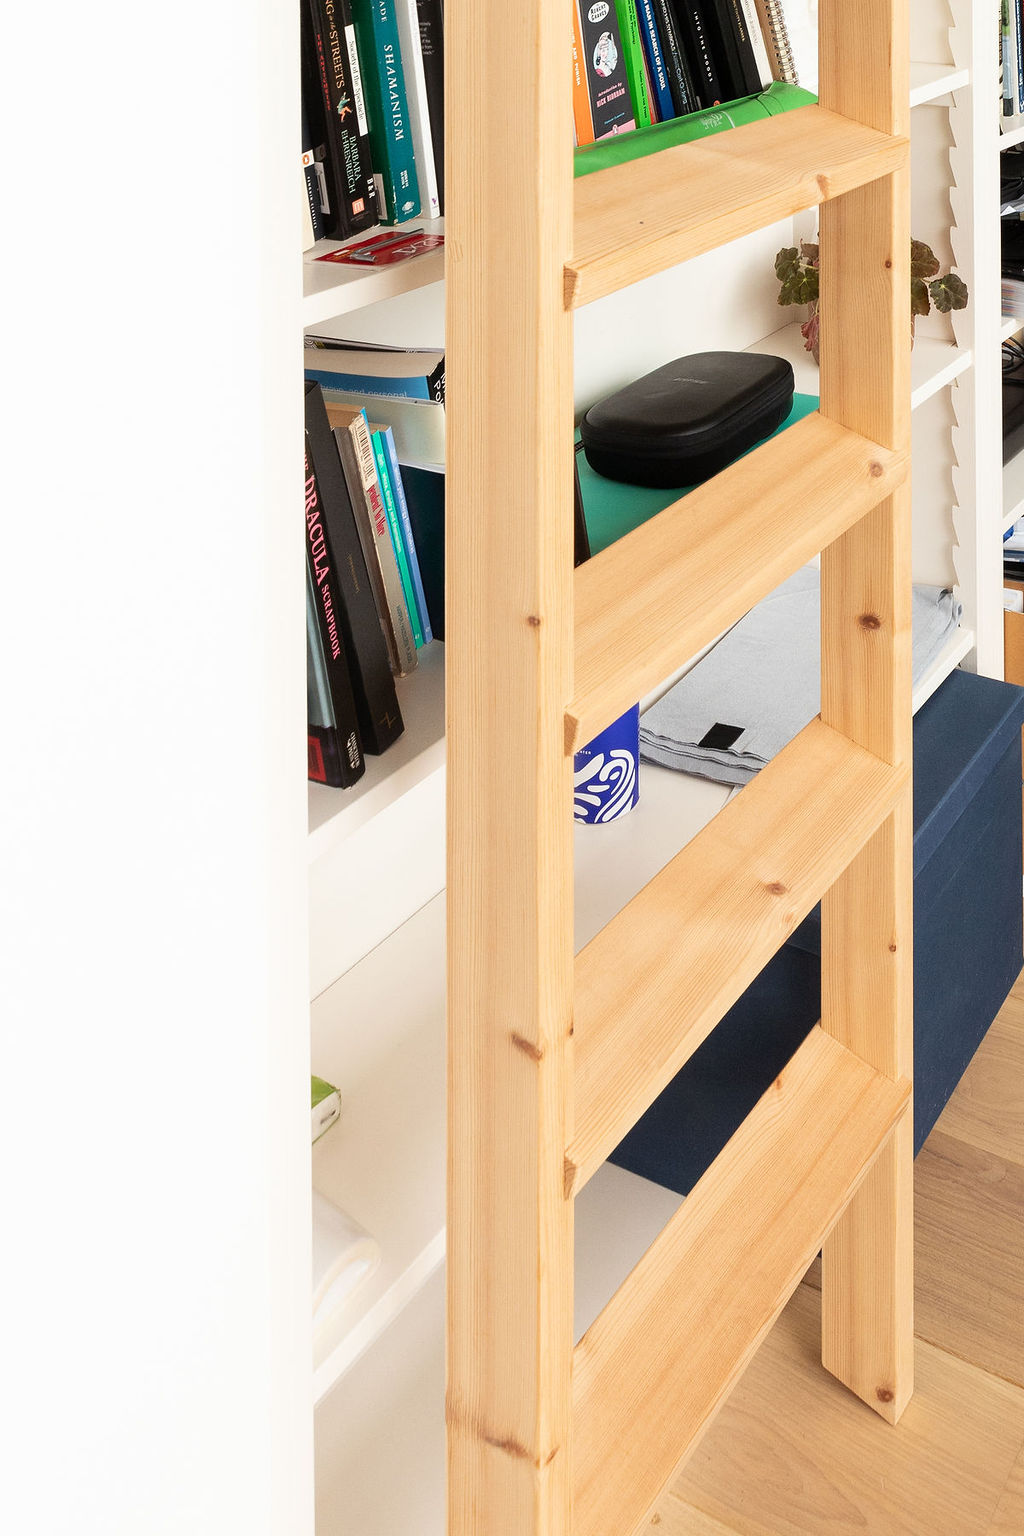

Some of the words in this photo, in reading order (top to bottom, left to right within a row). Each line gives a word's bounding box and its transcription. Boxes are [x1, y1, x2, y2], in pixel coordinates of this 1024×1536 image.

[643, 4, 651, 21] MAN
[647, 20, 653, 30] IN
[349, 41, 359, 65] Society
[648, 29, 659, 56] SEARCH
[692, 10, 701, 31] INTO
[703, 53, 713, 83] WOODS
[330, 30, 345, 89] STREETS
[352, 65, 358, 73] of
[654, 56, 661, 66] OF
[384, 44, 404, 141] SHAMANISM
[657, 72, 666, 90] SOUL
[355, 86, 365, 120] Spectacle
[341, 129, 356, 194] EHRENREICH
[348, 136, 362, 181] BARBARA
[305, 474, 328, 586] DRACULA
[321, 583, 341, 660] SCRAPBOOK
